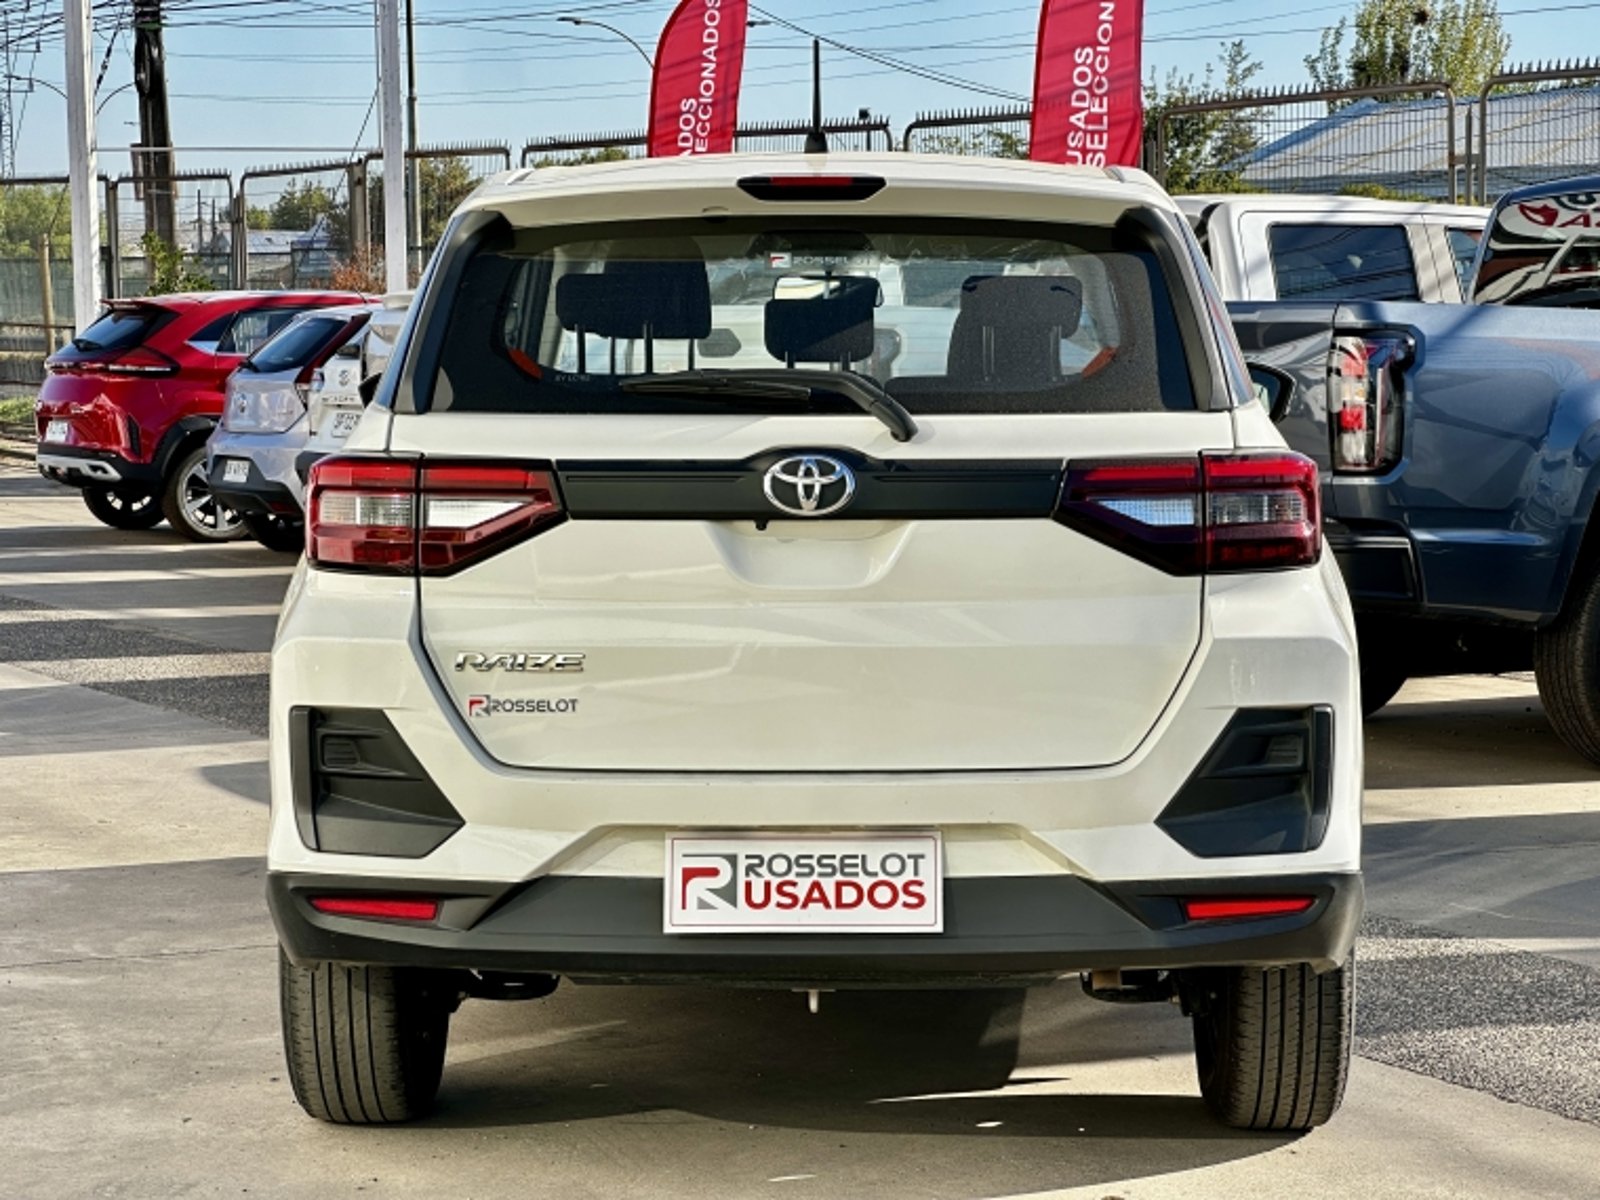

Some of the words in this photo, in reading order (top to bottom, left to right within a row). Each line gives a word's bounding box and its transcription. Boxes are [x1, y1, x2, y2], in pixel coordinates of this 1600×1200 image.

[455, 651, 586, 673] RAIZE
[491, 698, 579, 713] ROSSELOT
[744, 853, 926, 878] ROSSELOT
[744, 879, 927, 911] USADOS
